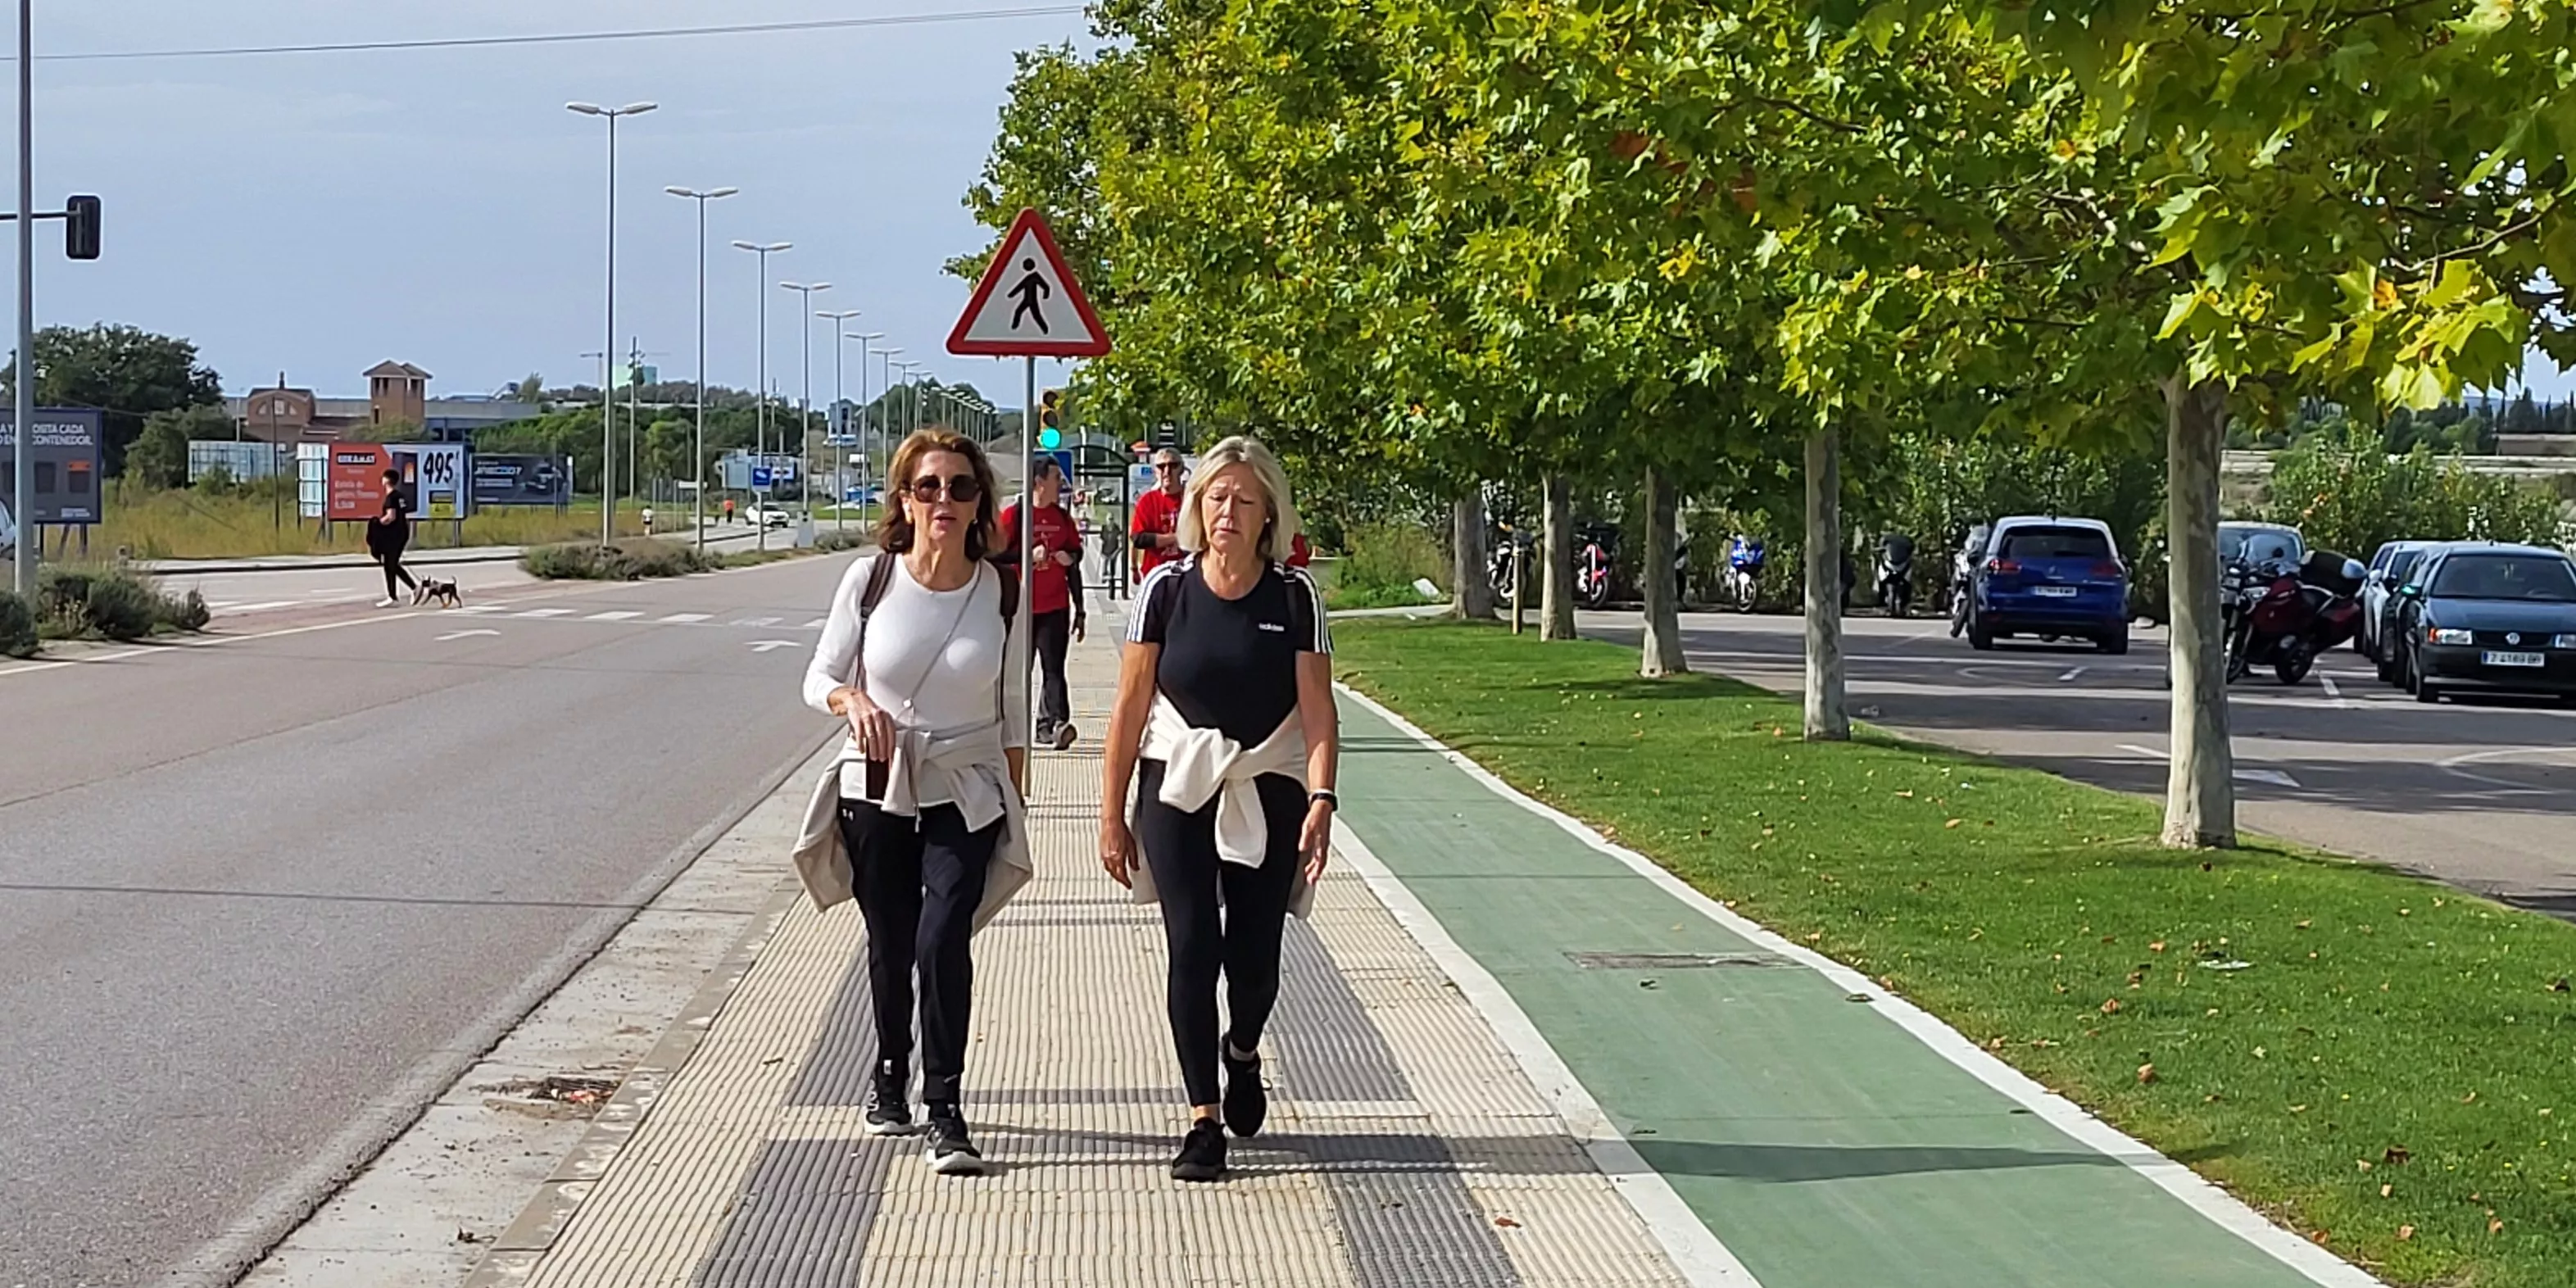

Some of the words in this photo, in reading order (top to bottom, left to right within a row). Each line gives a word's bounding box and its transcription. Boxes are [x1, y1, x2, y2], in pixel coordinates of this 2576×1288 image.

[33, 424, 57, 434] OSITA
[59, 424, 85, 434] CADA
[1259, 623, 1285, 632] adidas
